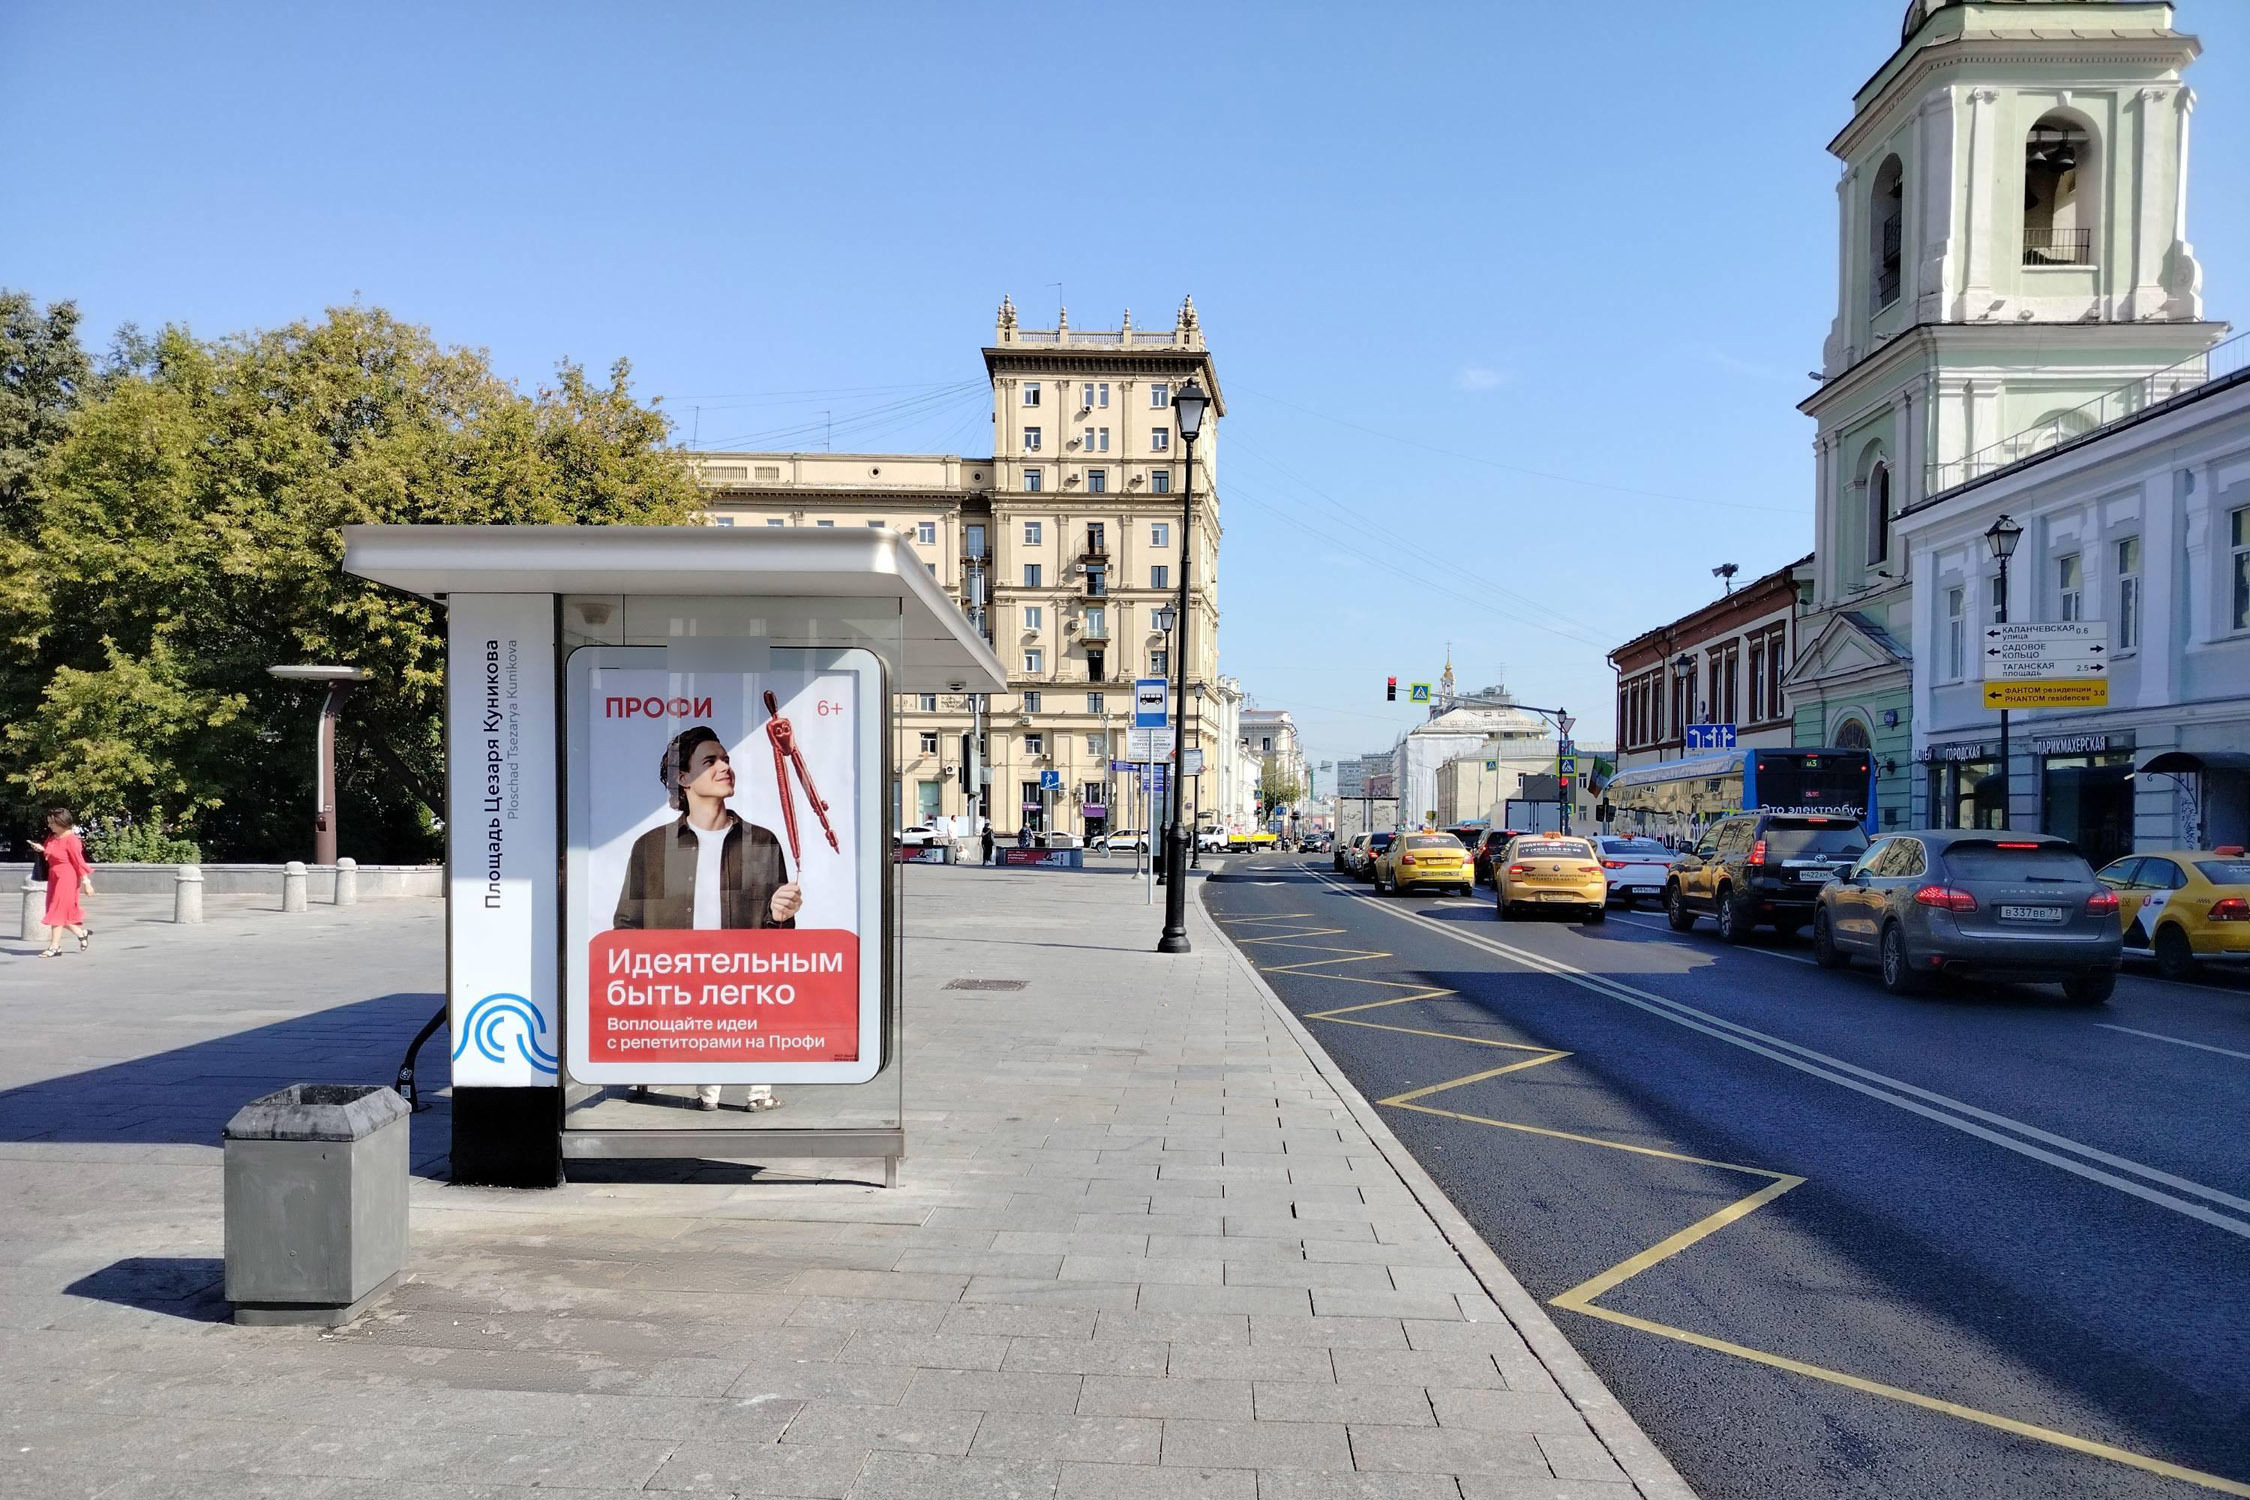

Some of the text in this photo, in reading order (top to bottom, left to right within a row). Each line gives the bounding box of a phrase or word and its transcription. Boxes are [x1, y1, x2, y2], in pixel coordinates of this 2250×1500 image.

[2002, 624, 2074, 633] КАЛАНЧЕВСКАЯ
[2002, 643, 2047, 651] САДОВОЕ
[2002, 652, 2040, 660] КОЛЬЦО
[2002, 662, 2089, 672] ТАГАНСКАЯ 2.5
[2043, 687, 2092, 695] резиденции
[2093, 689, 2105, 697] 3.0
[2047, 694, 2091, 702] residences
[605, 696, 844, 719] ПРОФИ 6+
[506, 640, 520, 820] Ploschad Tsezarya Kunikova
[1945, 745, 1981, 761] ГОРОДСКАЯ
[2037, 736, 2106, 755] ПАРИКМАХЕРСКАЯ
[483, 639, 503, 909] Площадь Цезаря Куникова
[1761, 803, 1867, 816] Это электробус.
[608, 948, 843, 979] Идеятельным
[607, 980, 796, 1006] быть легко
[607, 1016, 758, 1034] Воплощайте идеи
[607, 1034, 825, 1052] с репетиторами на Профи
